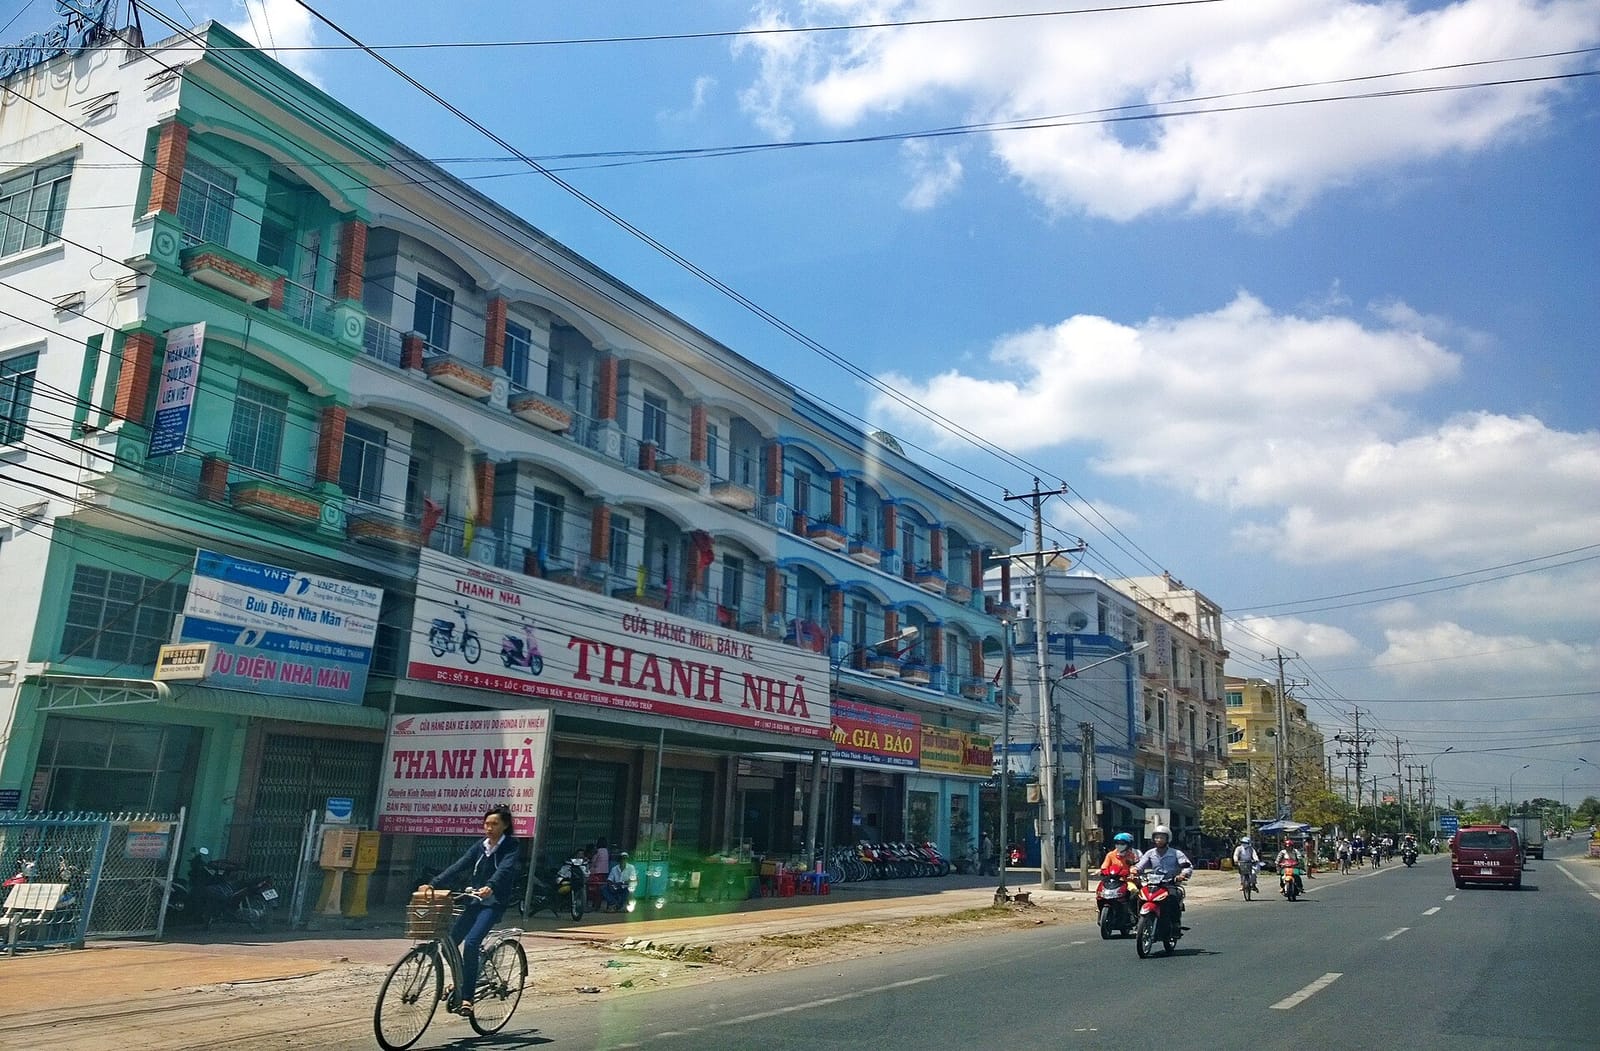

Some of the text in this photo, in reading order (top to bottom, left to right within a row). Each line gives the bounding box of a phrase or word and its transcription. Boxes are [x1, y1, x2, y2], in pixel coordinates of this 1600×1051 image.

[263, 568, 296, 582] VNPT
[455, 580, 494, 600] THANH
[246, 596, 268, 614] Bưu
[270, 600, 294, 620] Điện
[298, 605, 317, 622] Nha
[623, 606, 754, 661] CỬA HÀNG MUA BÁN XE
[164, 650, 199, 658] WESTERN
[172, 657, 198, 666] UNION
[236, 654, 278, 685] ĐIỆN
[280, 662, 314, 686] NHA
[316, 664, 353, 692] MÂN
[567, 636, 724, 704] THANH
[741, 671, 811, 719] NHÃ
[536, 686, 549, 695] NHA
[431, 719, 444, 730] HÀNG
[446, 718, 457, 730] BÁN
[458, 720, 465, 730] XE
[465, 720, 470, 730] &
[470, 719, 482, 732] DỊCH
[491, 720, 499, 729] DO
[500, 718, 518, 730] HONDA
[852, 728, 880, 750] GIA
[883, 729, 913, 754] BẢO
[392, 749, 477, 779] THANH
[437, 789, 442, 797] &
[443, 788, 458, 798] TRAO
[470, 786, 482, 798] CÁC
[498, 788, 506, 798] XE
[386, 802, 398, 814] BÁN
[431, 804, 451, 814] HONDA
[453, 804, 458, 813] &
[524, 804, 533, 812] XE
